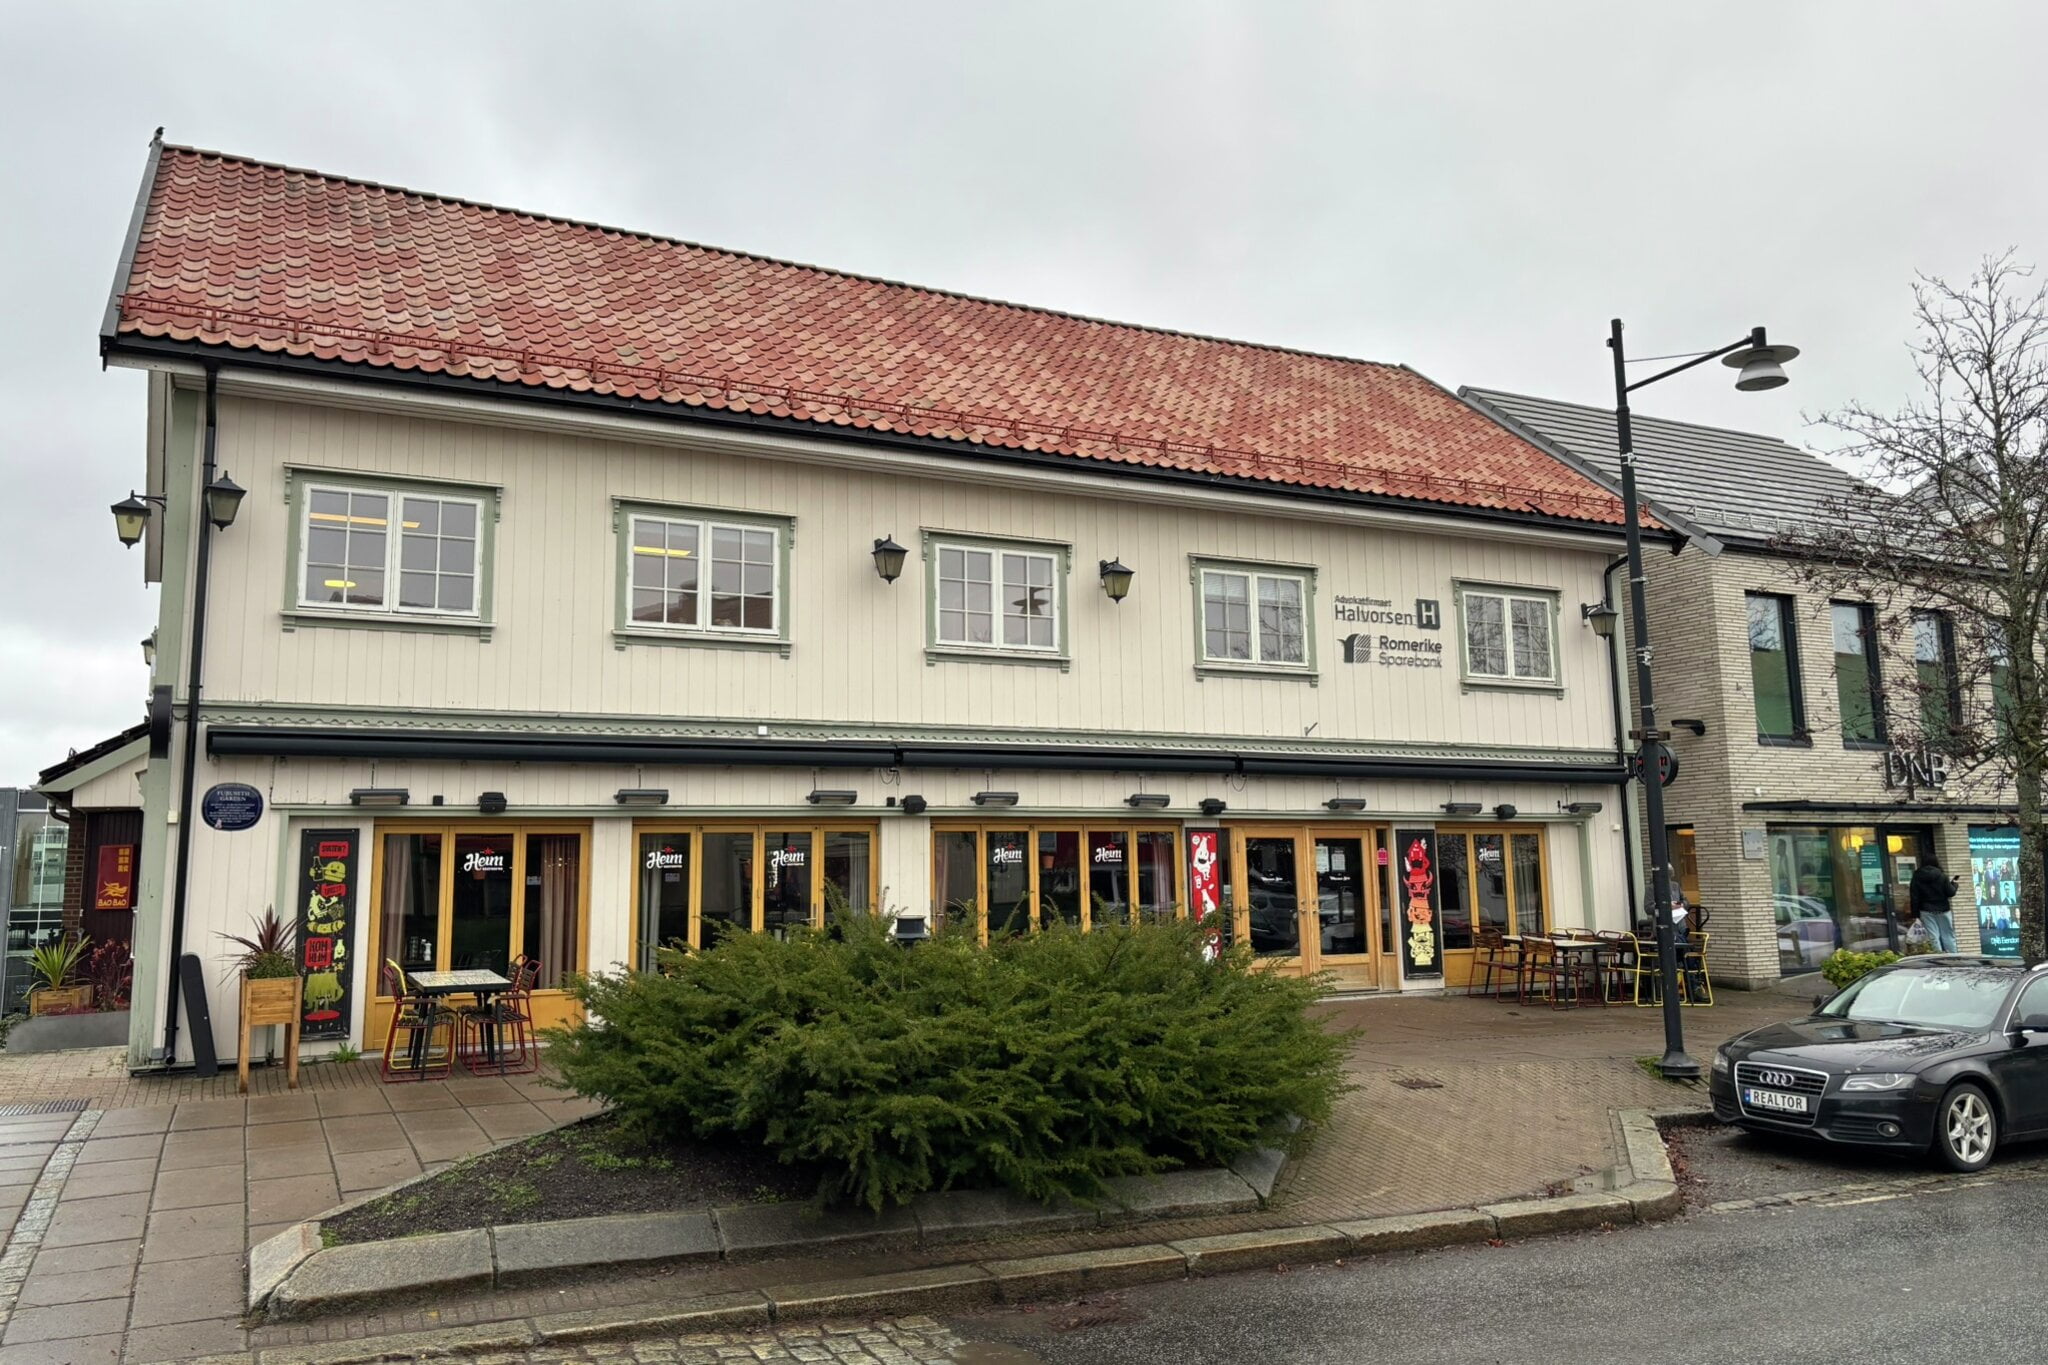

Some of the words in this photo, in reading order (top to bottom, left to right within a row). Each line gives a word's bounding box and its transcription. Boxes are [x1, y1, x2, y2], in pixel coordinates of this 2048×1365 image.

[1334, 595, 1392, 607] Advokatfirmaet
[1335, 604, 1413, 625] Halvorsen
[1379, 636, 1442, 653] Romerike
[1379, 652, 1442, 668] Sparebank
[1885, 752, 1947, 789] DNB
[463, 853, 504, 872] Heim
[646, 851, 683, 869] Heim
[771, 850, 805, 867] Heim
[993, 848, 1022, 863] Heim
[1095, 848, 1122, 862] Heim
[1478, 847, 1500, 862] Heim
[98, 898, 113, 907] BAO
[113, 898, 127, 907] BAO
[1753, 1091, 1802, 1109] REALTOR
